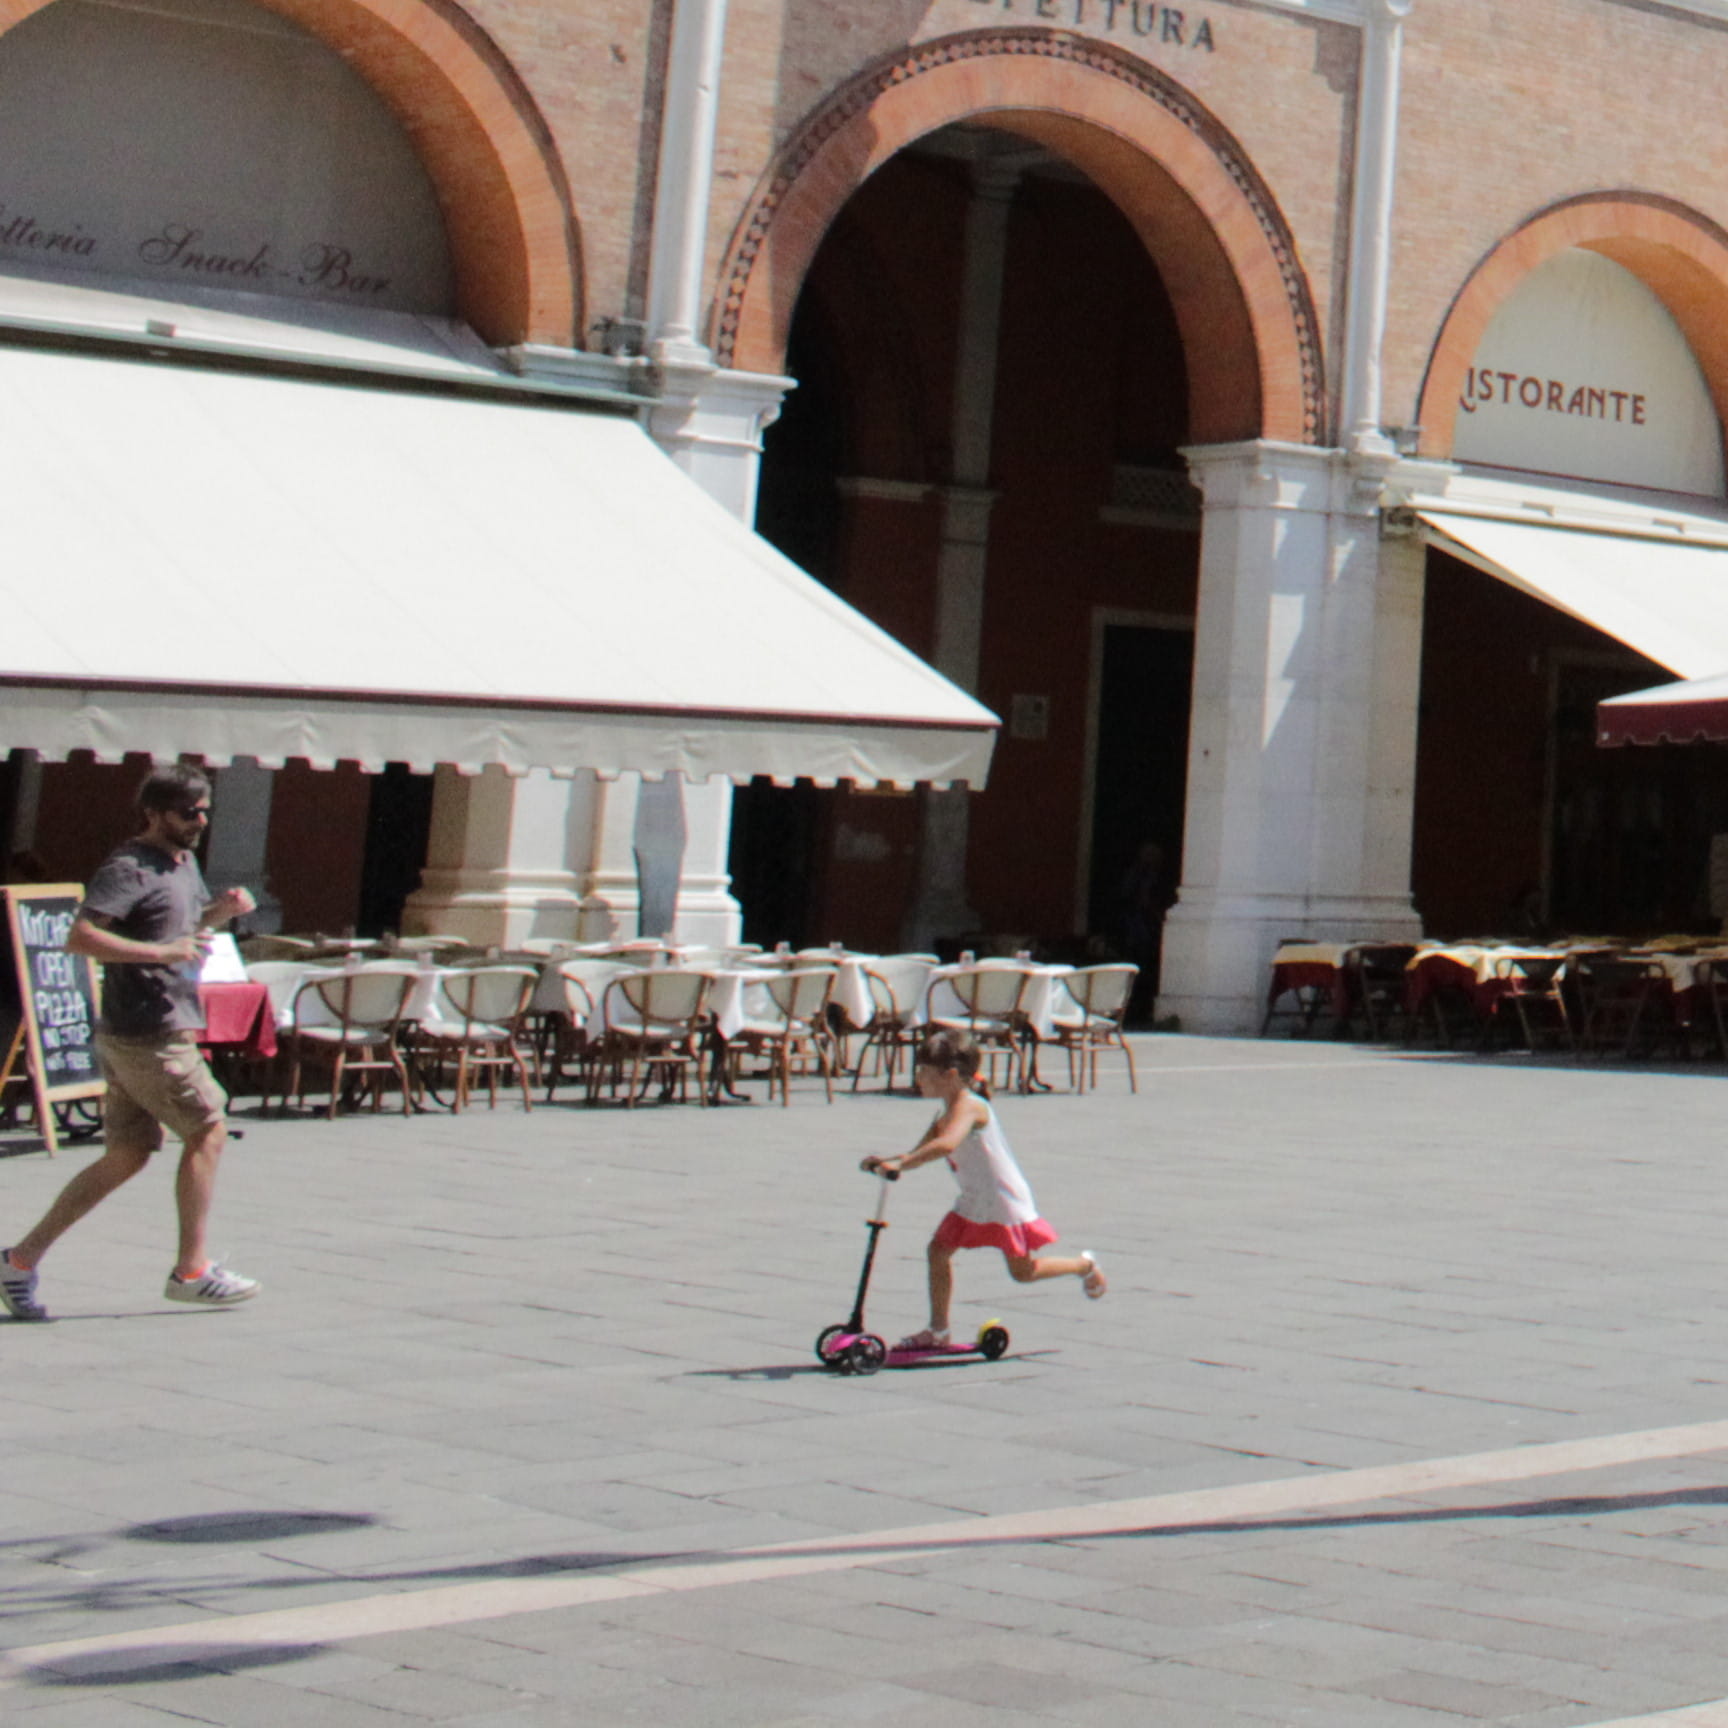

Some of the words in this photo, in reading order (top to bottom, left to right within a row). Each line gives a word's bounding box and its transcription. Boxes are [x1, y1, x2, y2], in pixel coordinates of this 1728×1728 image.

[0, 215, 97, 257] tteria
[1459, 366, 1647, 425] ISTORANTE
[19, 903, 80, 947] KITCHE
[37, 952, 75, 988] OPEN
[34, 990, 89, 1027] PIZZA
